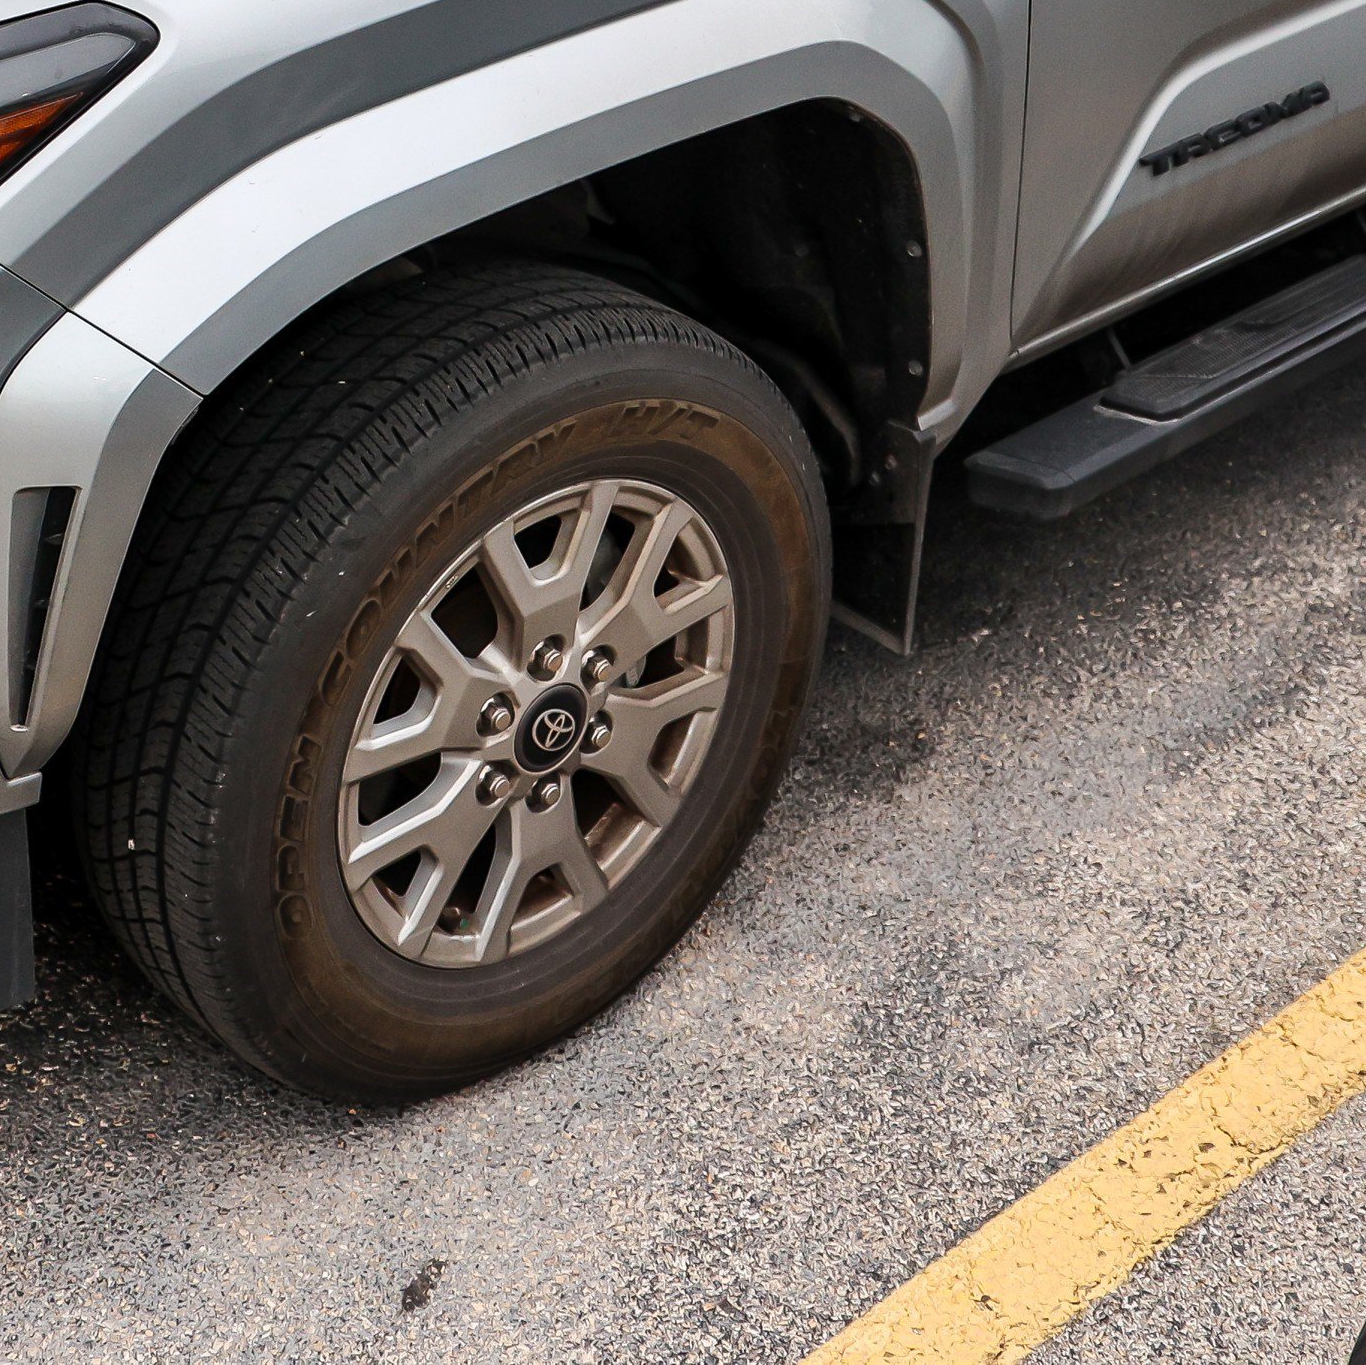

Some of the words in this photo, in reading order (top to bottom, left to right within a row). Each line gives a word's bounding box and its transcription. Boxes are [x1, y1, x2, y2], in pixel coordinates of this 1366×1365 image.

[1138, 80, 1331, 177] TACOMA
[276, 733, 323, 940] OPEN
[318, 420, 578, 706] COUNTRY
[607, 399, 722, 440] H/T
